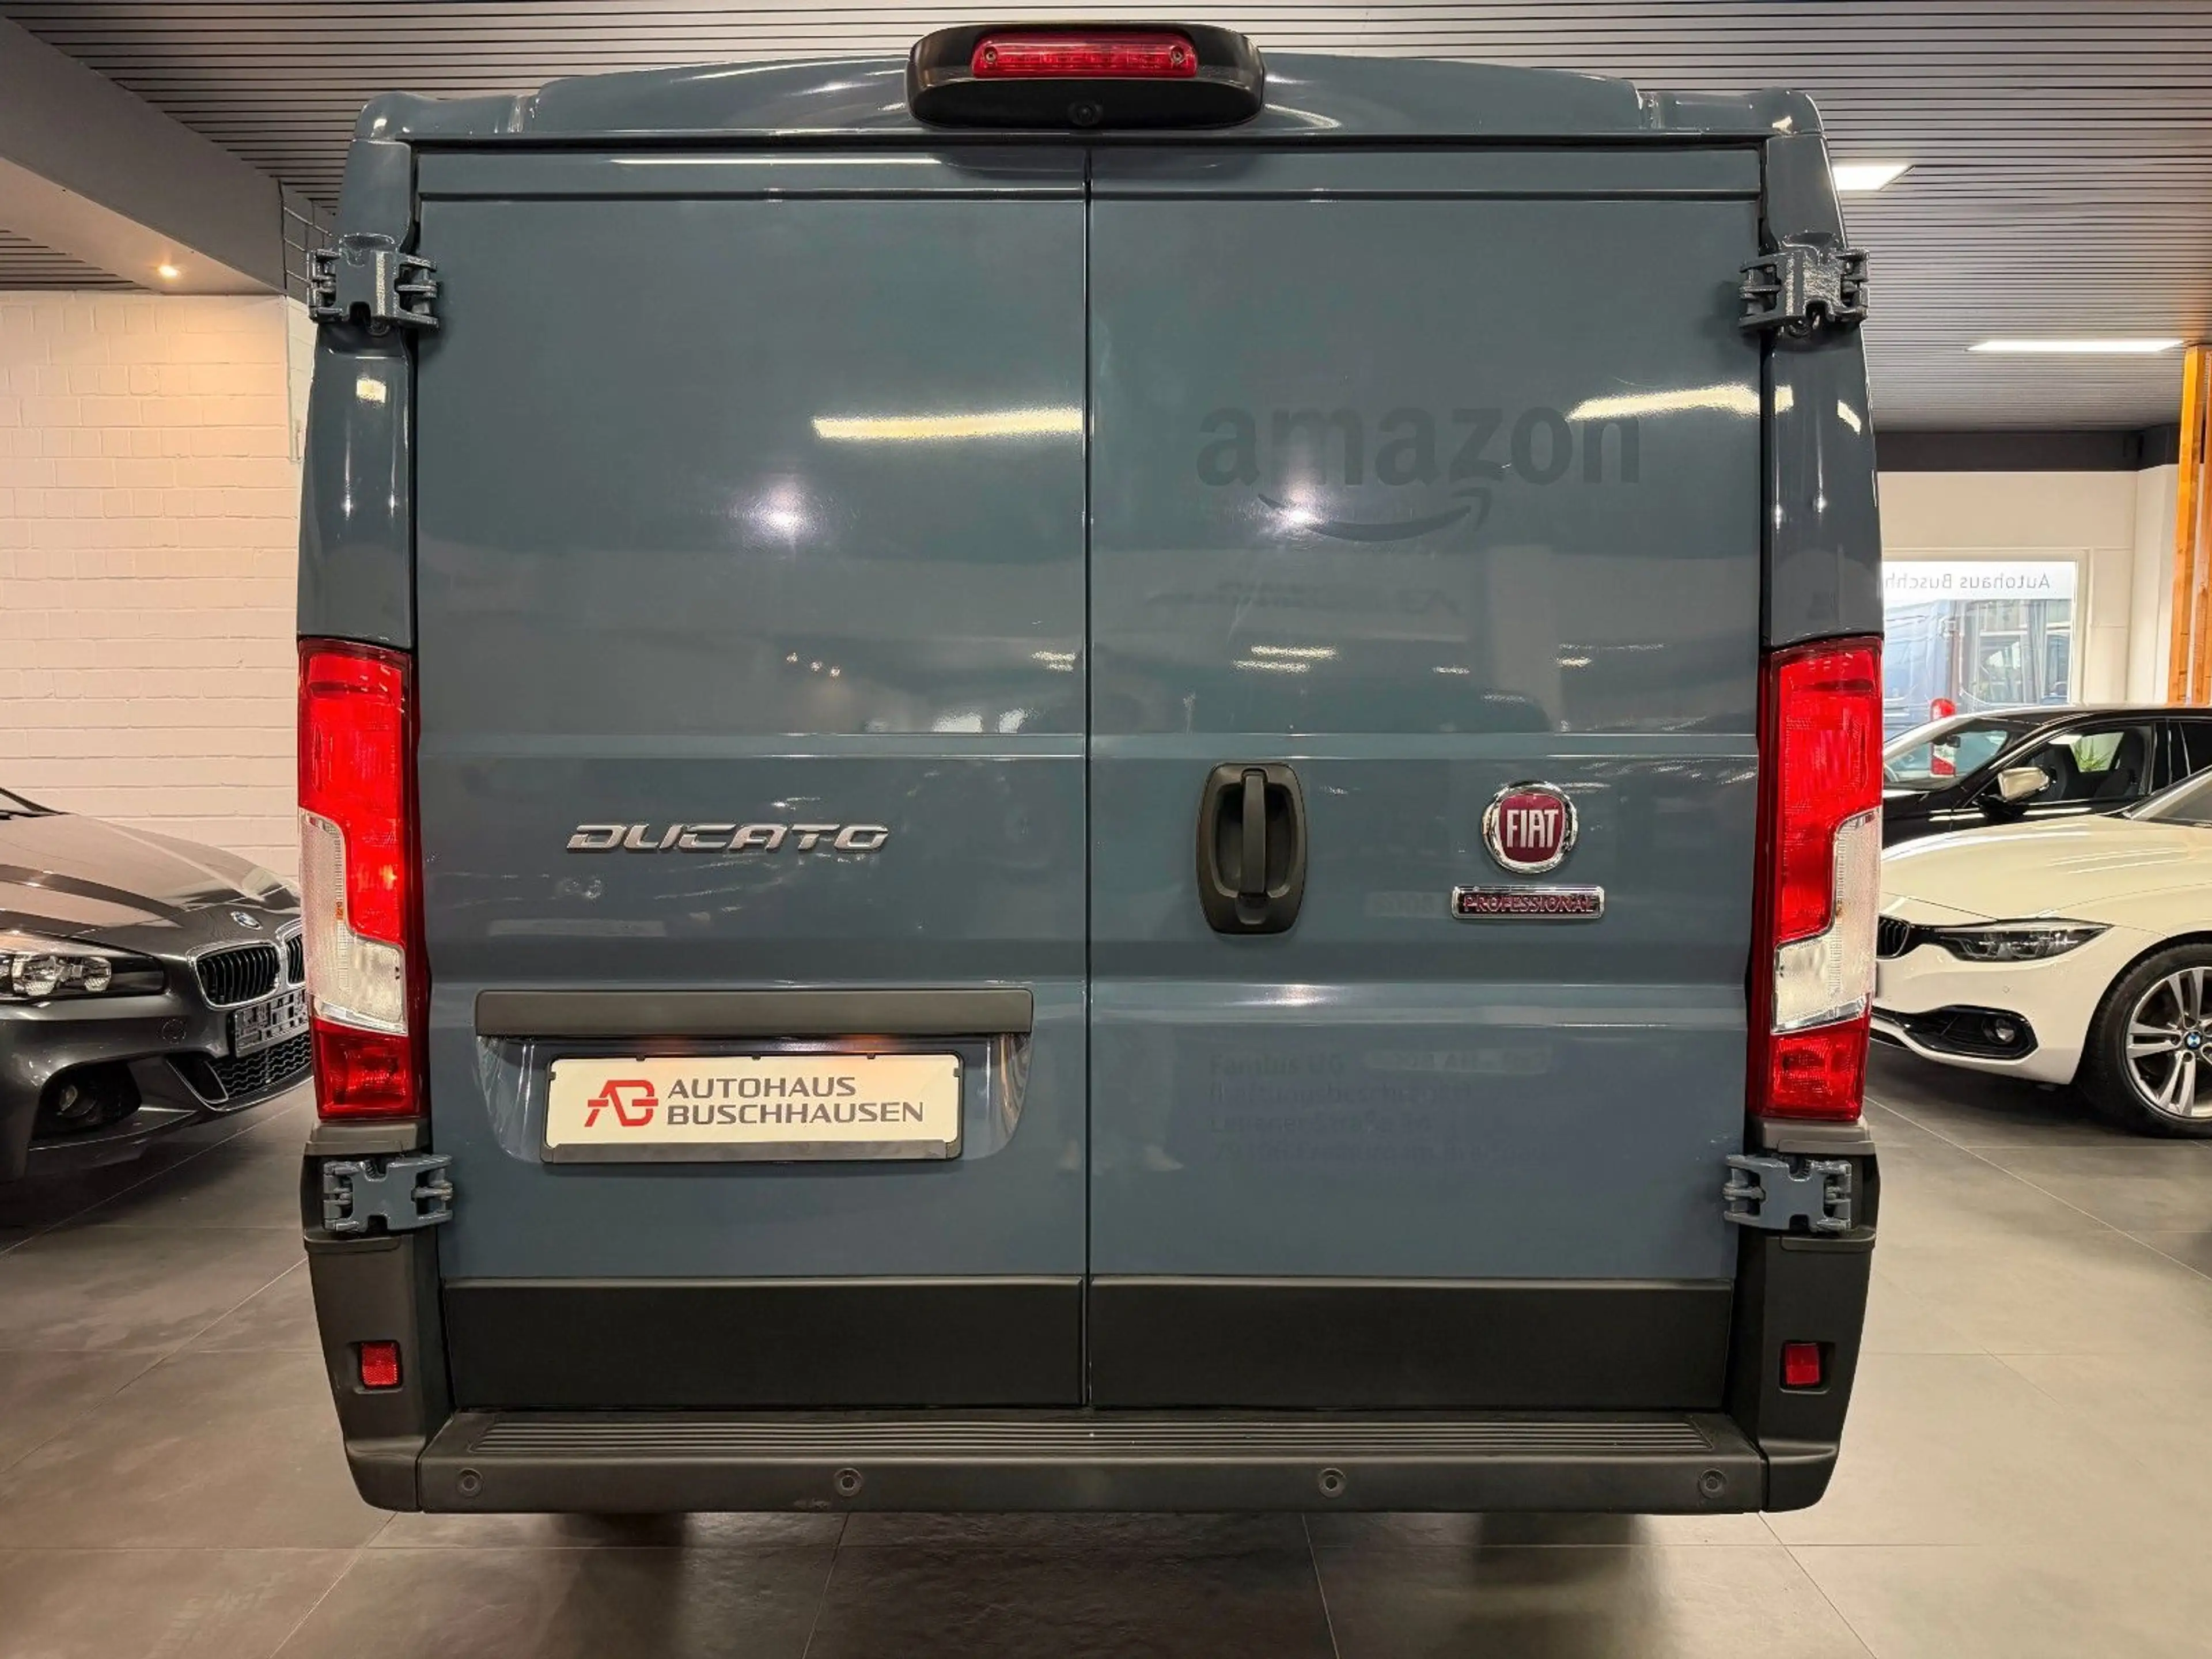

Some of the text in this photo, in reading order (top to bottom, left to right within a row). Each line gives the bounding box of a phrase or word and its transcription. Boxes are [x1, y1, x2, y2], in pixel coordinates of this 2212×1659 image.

[1196, 406, 1639, 486] amazon
[566, 824, 889, 851] DUCATO
[1506, 809, 1559, 848] FIAT
[1463, 895, 1599, 912] PROFESSIONAL
[668, 1077, 856, 1099] AUTOHAUS
[667, 1101, 924, 1126] BUSCHHAUSEN
